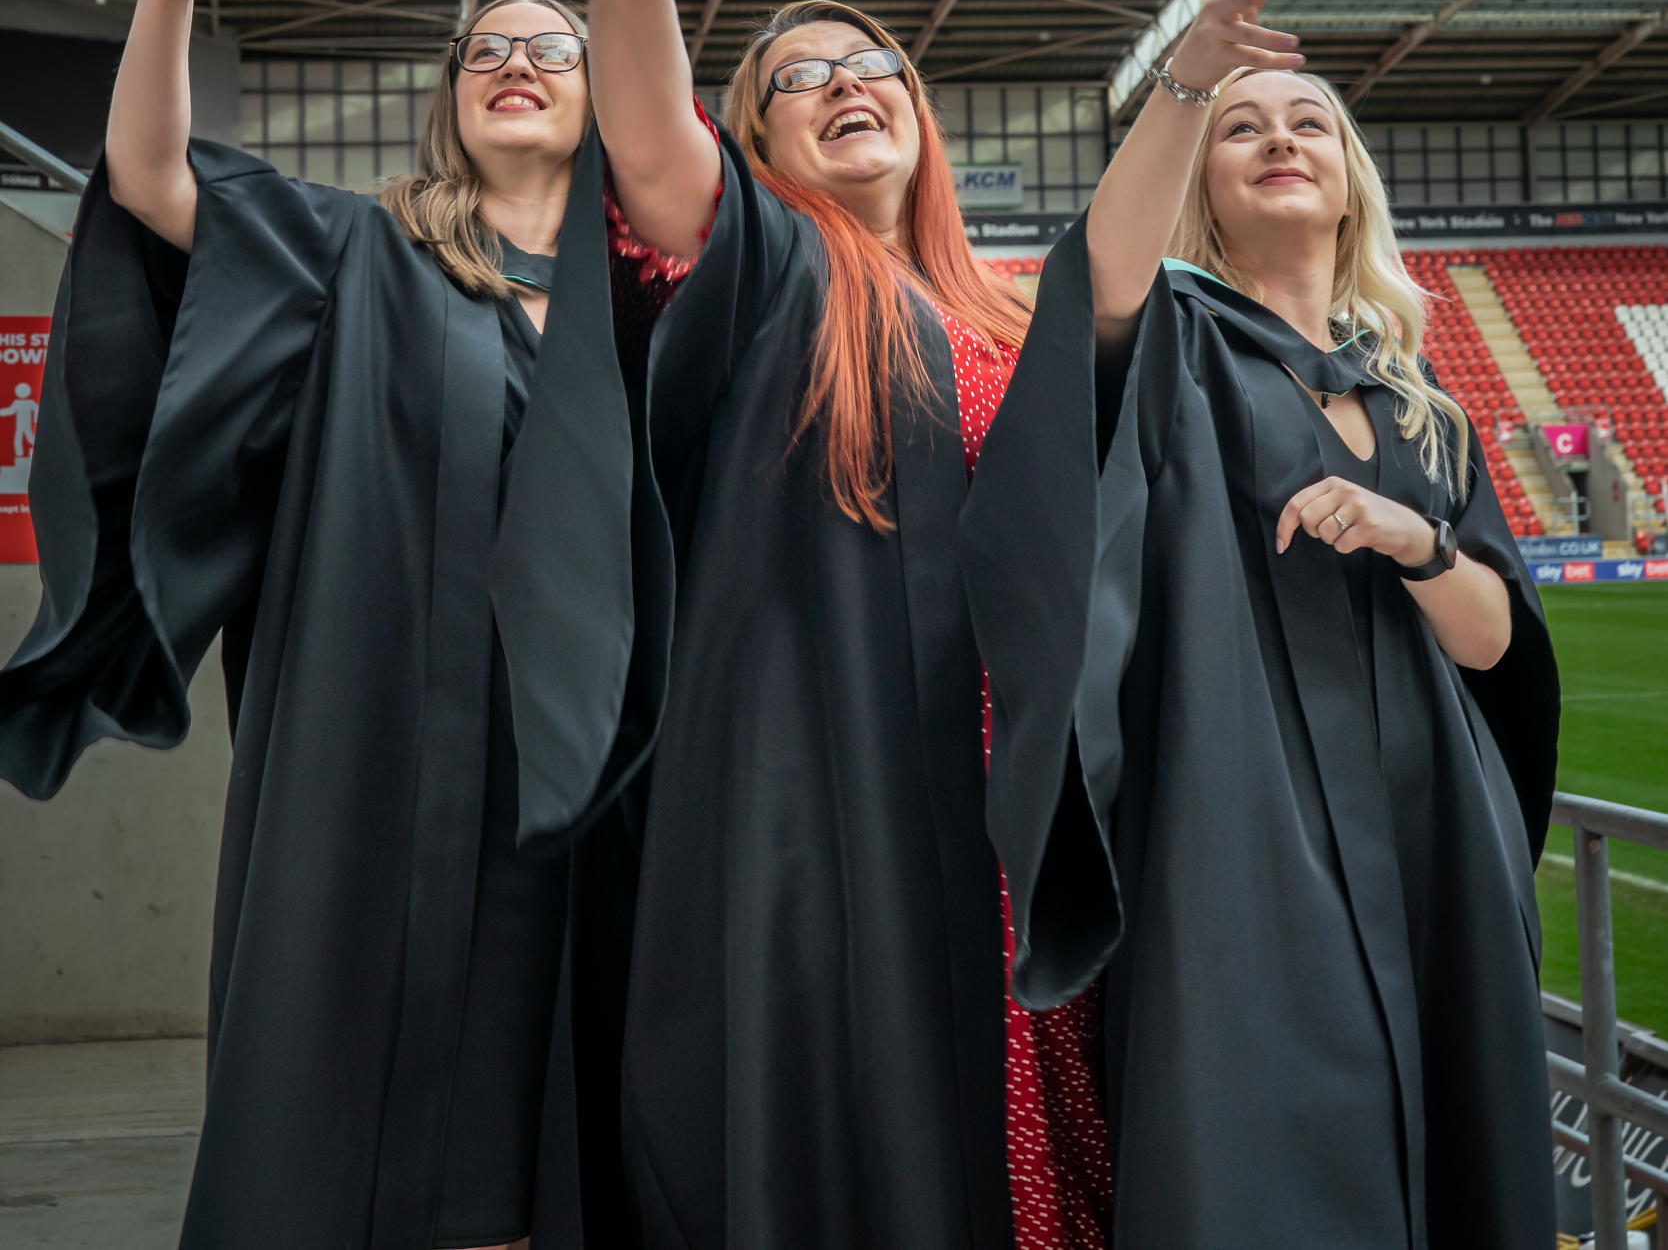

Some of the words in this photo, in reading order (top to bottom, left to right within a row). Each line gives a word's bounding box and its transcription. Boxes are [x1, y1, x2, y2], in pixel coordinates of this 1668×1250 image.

[965, 172, 1016, 188] KCM
[982, 223, 1039, 237] Stadium
[1418, 216, 1446, 230] York
[1450, 215, 1504, 230] Stadium
[0, 348, 47, 365] OW
[1556, 432, 1573, 454] C
[1536, 562, 1563, 583] sky
[1565, 564, 1591, 580] bet
[1617, 561, 1644, 581] sky
